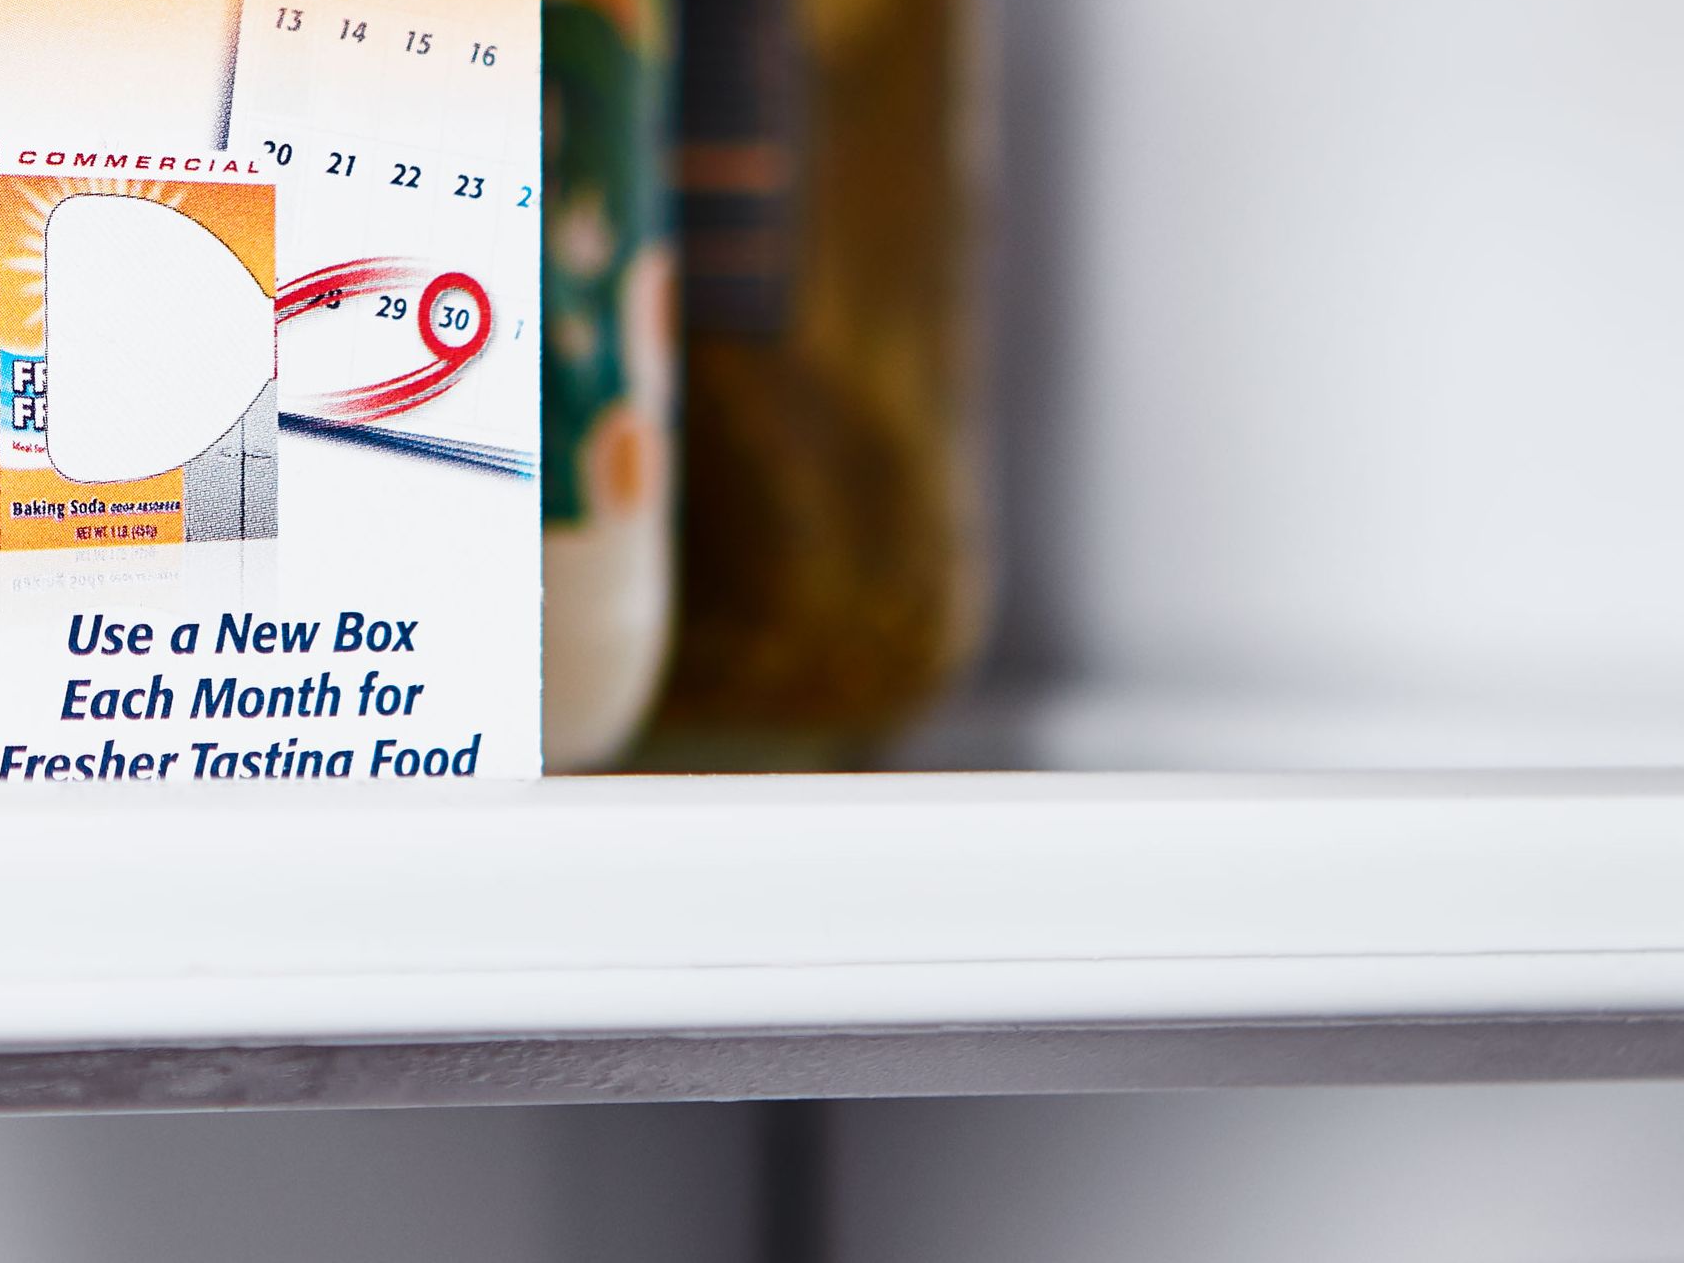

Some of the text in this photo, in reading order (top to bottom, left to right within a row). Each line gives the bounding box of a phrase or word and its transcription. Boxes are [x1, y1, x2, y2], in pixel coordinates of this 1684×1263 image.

[277, 8, 496, 66] 13 14 15 16
[19, 147, 258, 173] COMMERCIAL
[327, 152, 355, 176] 21
[391, 164, 421, 188] 22
[454, 175, 484, 198] 23
[376, 296, 406, 319] 29
[439, 307, 469, 330] 30
[12, 501, 65, 519] Baking
[70, 499, 106, 515] Soda
[68, 612, 418, 655] Use a New Box
[61, 671, 424, 720] Each Month for
[0, 740, 179, 779] Fresher
[371, 734, 481, 777] Food
